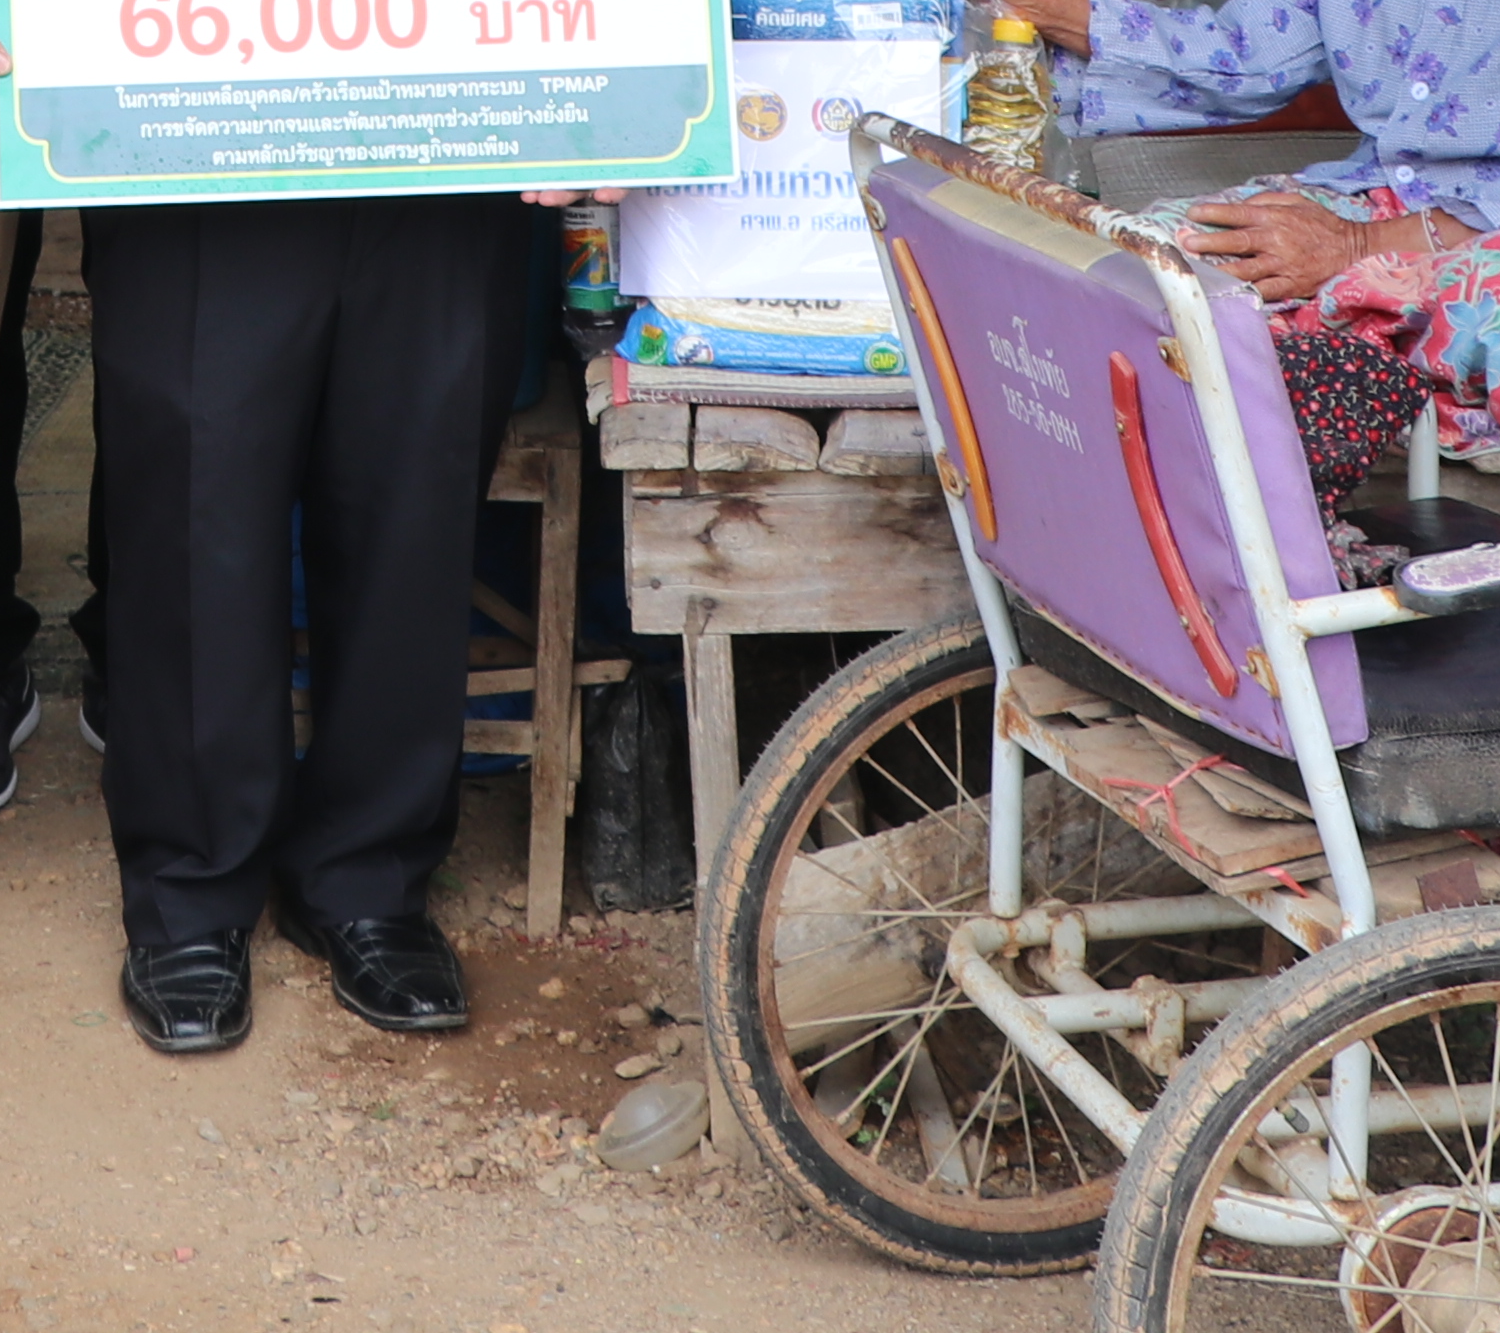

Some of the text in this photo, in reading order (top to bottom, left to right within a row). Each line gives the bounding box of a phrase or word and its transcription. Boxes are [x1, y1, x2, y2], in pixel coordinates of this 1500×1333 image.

[755, 7, 827, 28] คัดพิเศษ
[115, 75, 609, 112] ในการช่วยเหลือบุคคล/ครัวเรือนเป้าหมายจากระบบ TPMAP
[140, 98, 589, 139] การขจัดความยากจนและพัฒนาคนทุกช่วงวัยอย่างยั่งยืน
[212, 135, 520, 167] ตามหลักปรัชญาของเศรษฐกิจพอเพียง
[870, 351, 898, 372] GMP
